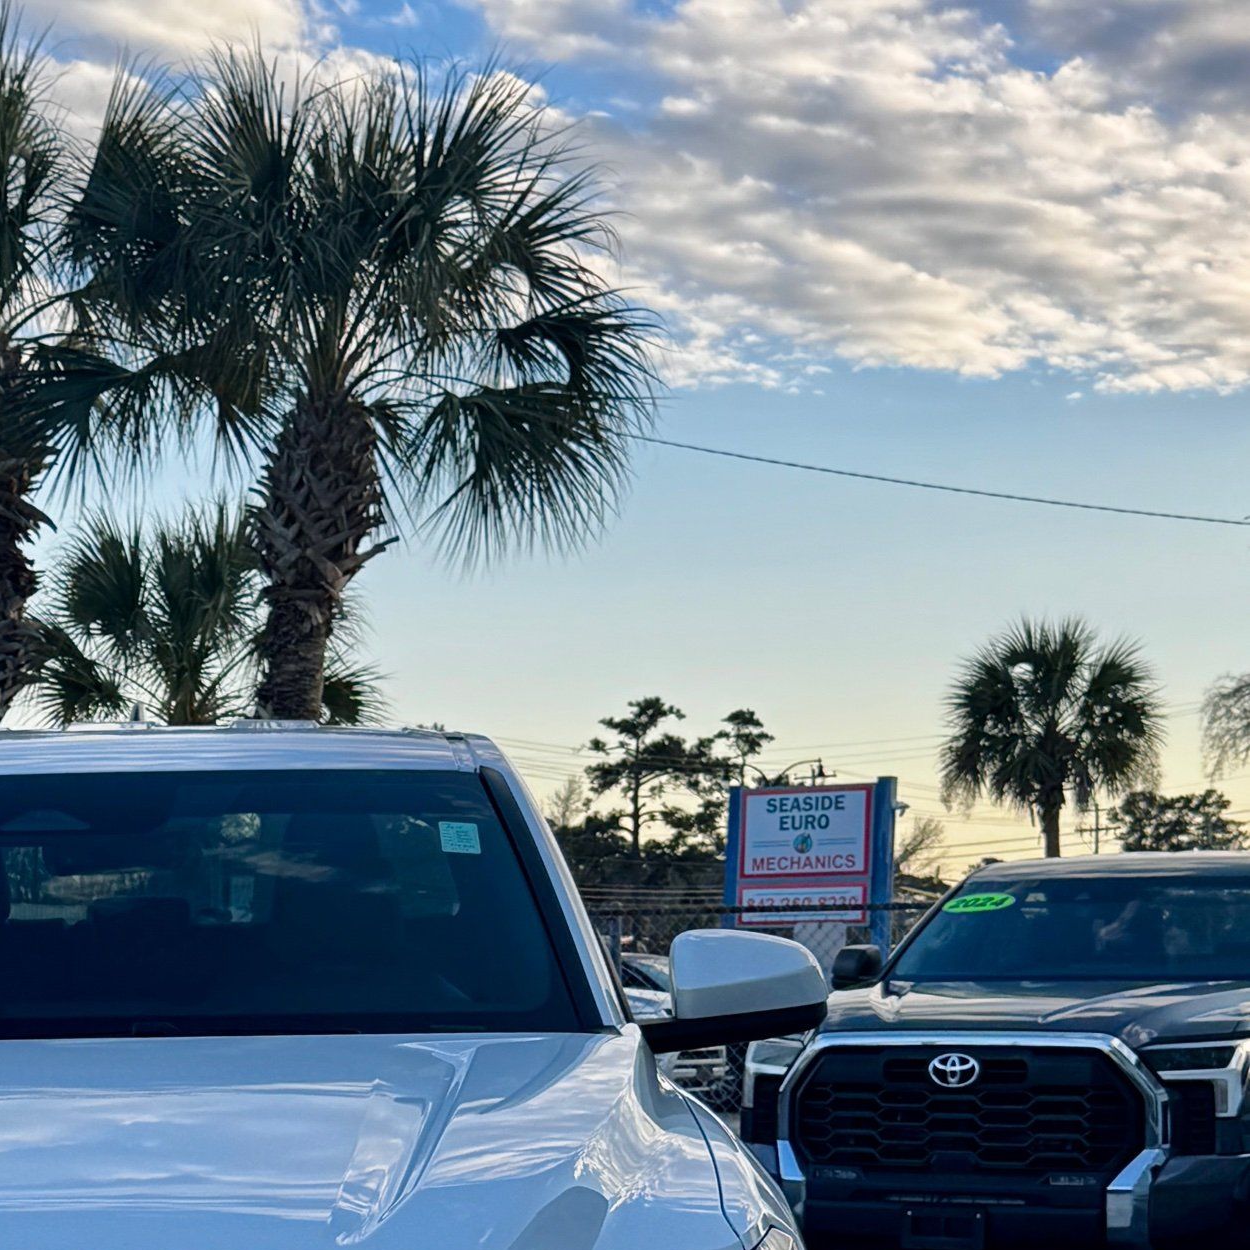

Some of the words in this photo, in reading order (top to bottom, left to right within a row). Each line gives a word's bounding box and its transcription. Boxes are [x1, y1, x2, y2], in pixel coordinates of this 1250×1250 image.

[766, 794, 846, 814] SEASIDE
[779, 813, 830, 831] EURO
[752, 854, 856, 871] MECHANICS
[948, 896, 1011, 909] 2024
